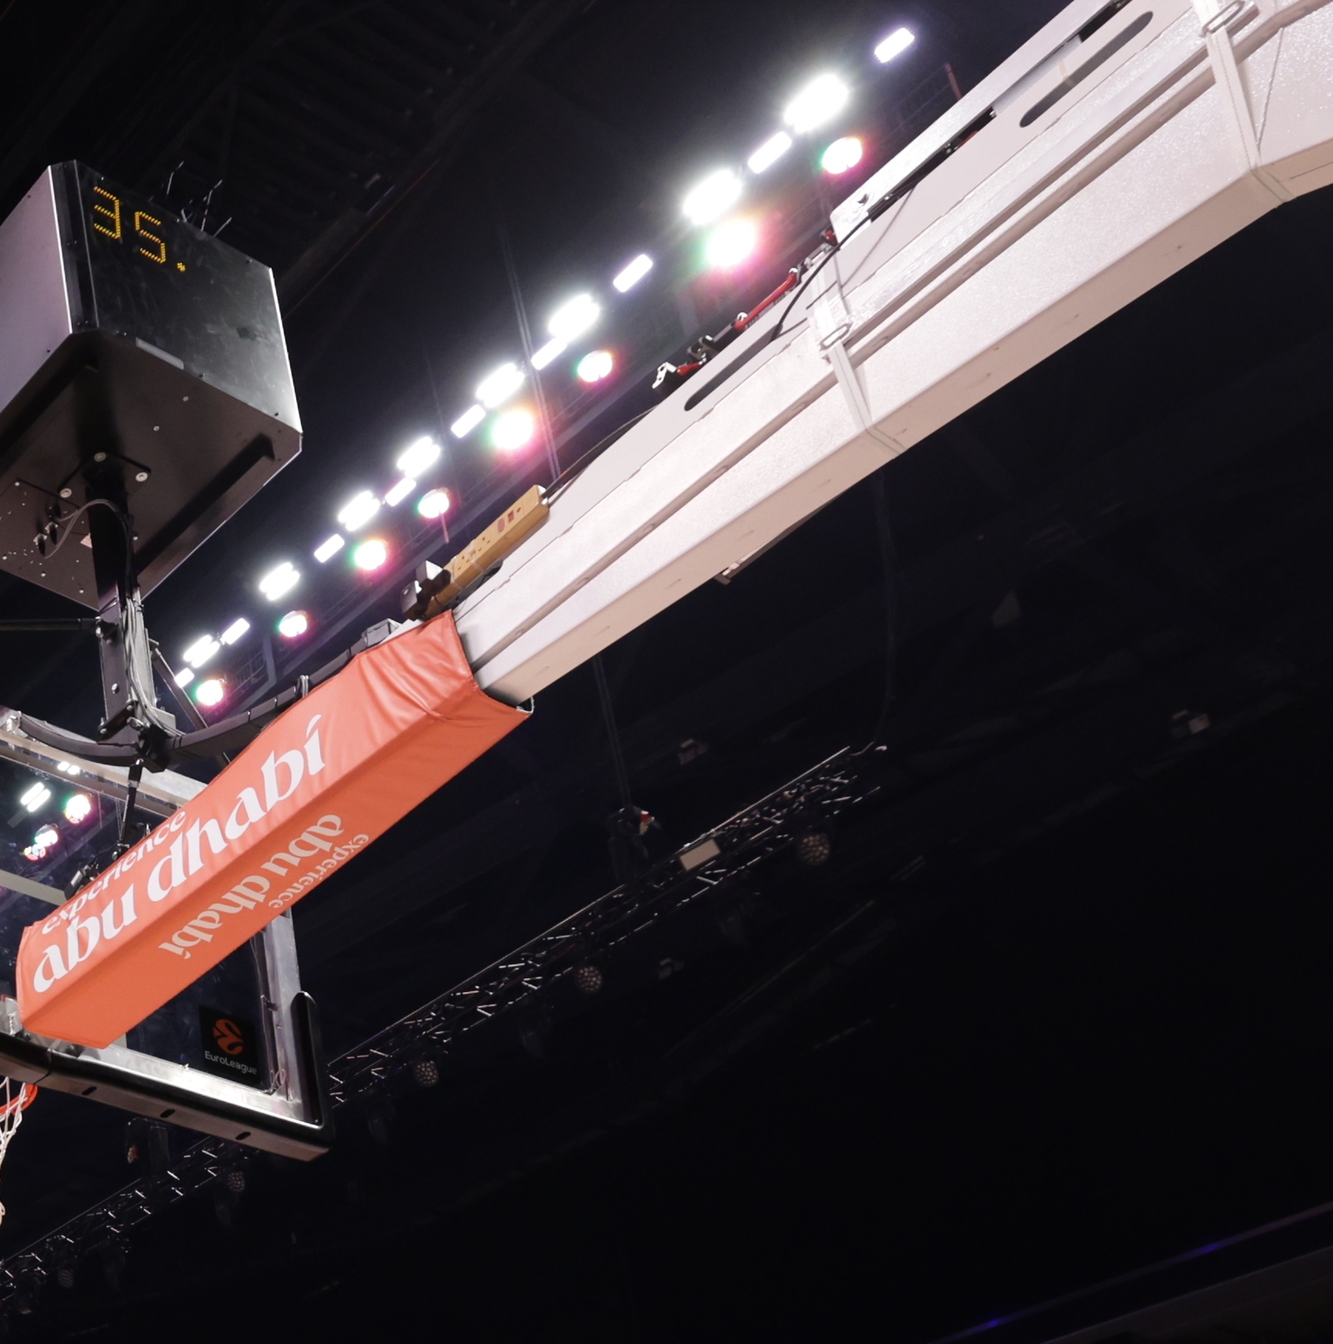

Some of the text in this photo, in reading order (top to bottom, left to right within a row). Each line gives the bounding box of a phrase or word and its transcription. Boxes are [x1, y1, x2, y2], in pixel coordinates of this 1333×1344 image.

[41, 811, 186, 935] experience
[261, 814, 343, 876] abu
[268, 834, 369, 909] experience
[33, 883, 137, 993] abu
[204, 1050, 257, 1074] EuroLeague
